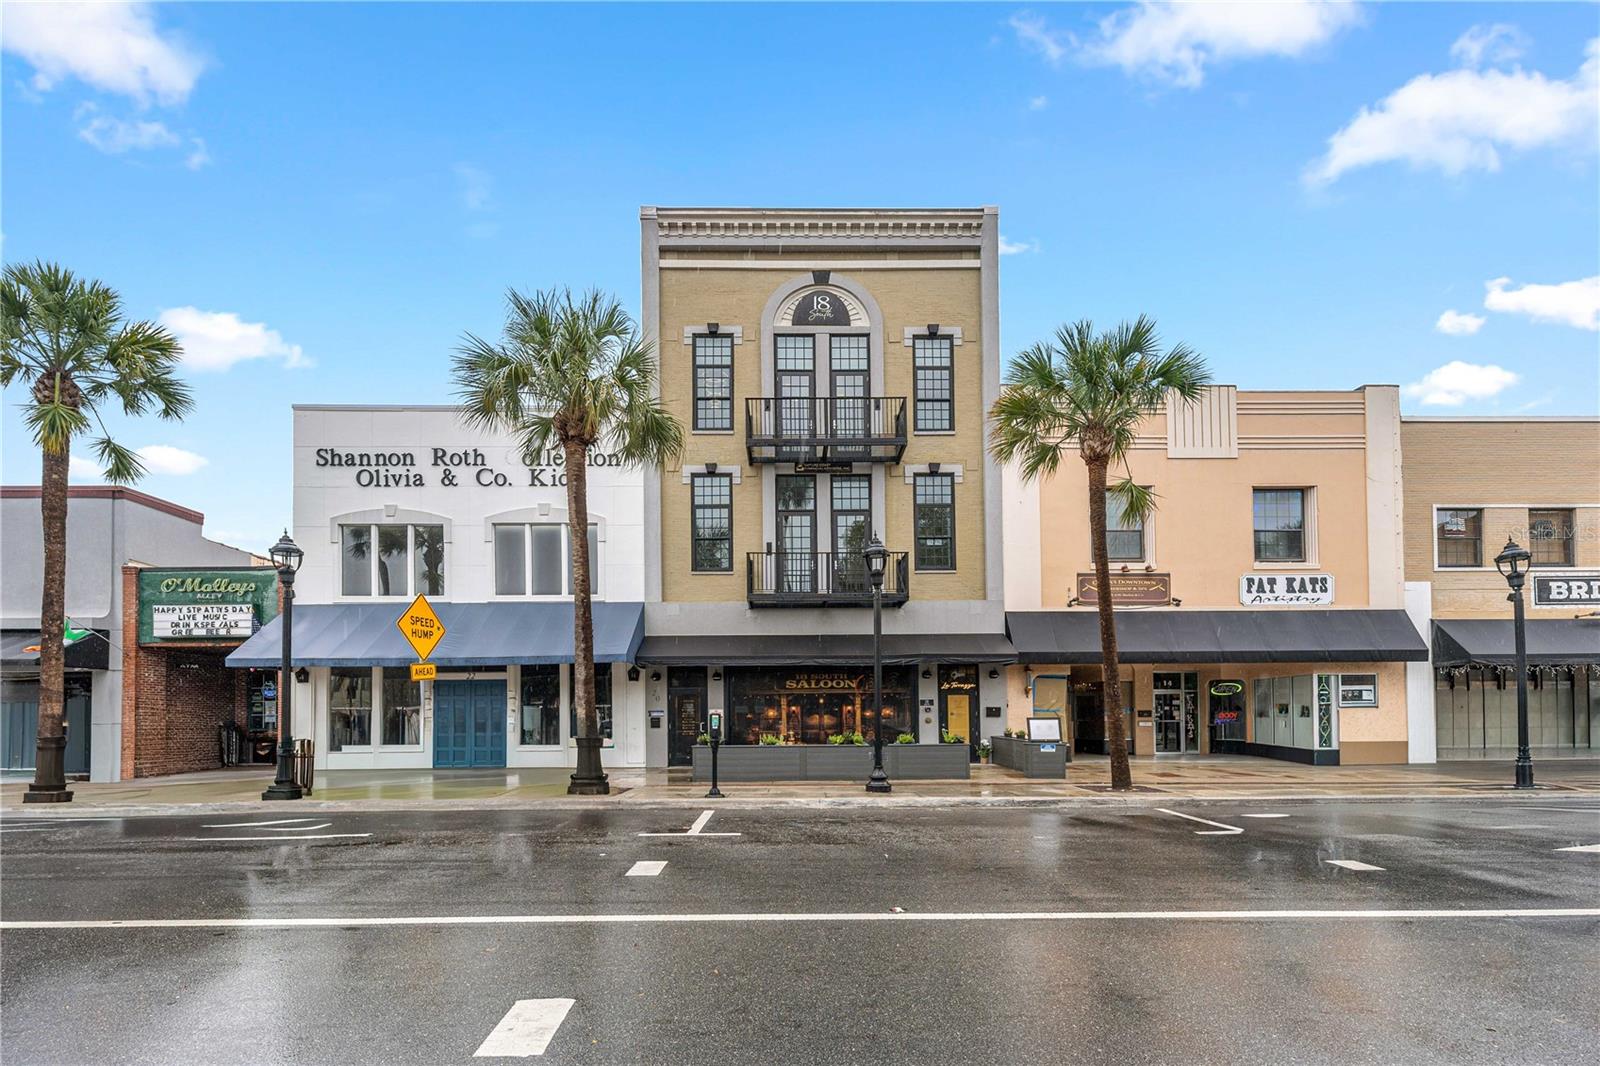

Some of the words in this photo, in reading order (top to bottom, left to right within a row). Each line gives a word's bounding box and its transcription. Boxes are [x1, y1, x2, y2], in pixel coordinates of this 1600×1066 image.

[813, 295, 830, 310] 18
[316, 448, 416, 467] Shannon
[431, 447, 487, 466] Roth
[356, 469, 425, 487] Olivia
[441, 468, 458, 487] &
[475, 468, 512, 487] Co.
[160, 578, 256, 596] O'Malleys
[1246, 577, 1277, 594] FAT
[1285, 577, 1328, 594] KATS
[1251, 595, 1323, 604] Artistry
[410, 616, 435, 628] SPEED
[411, 629, 434, 639] HUMP
[415, 668, 434, 676] AHEAD
[785, 679, 856, 688] SALOON
